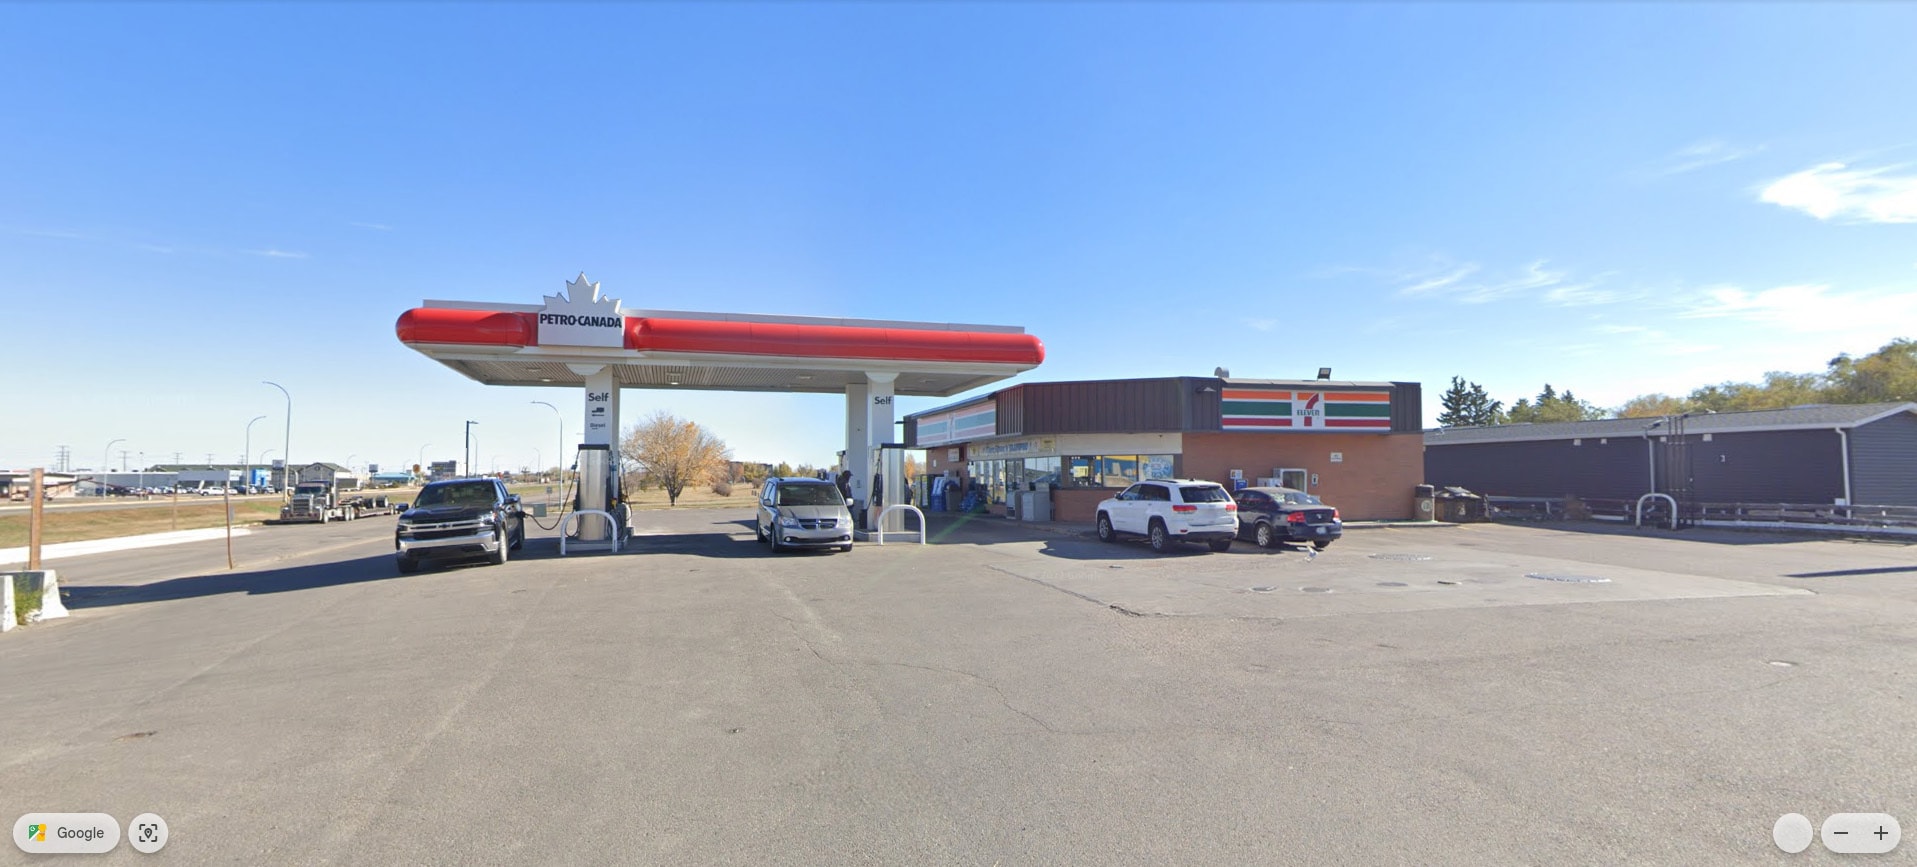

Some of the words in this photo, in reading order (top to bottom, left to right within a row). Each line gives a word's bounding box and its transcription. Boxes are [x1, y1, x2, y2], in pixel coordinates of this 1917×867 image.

[539, 313, 622, 328] PETRO-CANADA
[588, 392, 609, 402] Self
[874, 396, 892, 405] Self
[1296, 392, 1320, 427] 7
